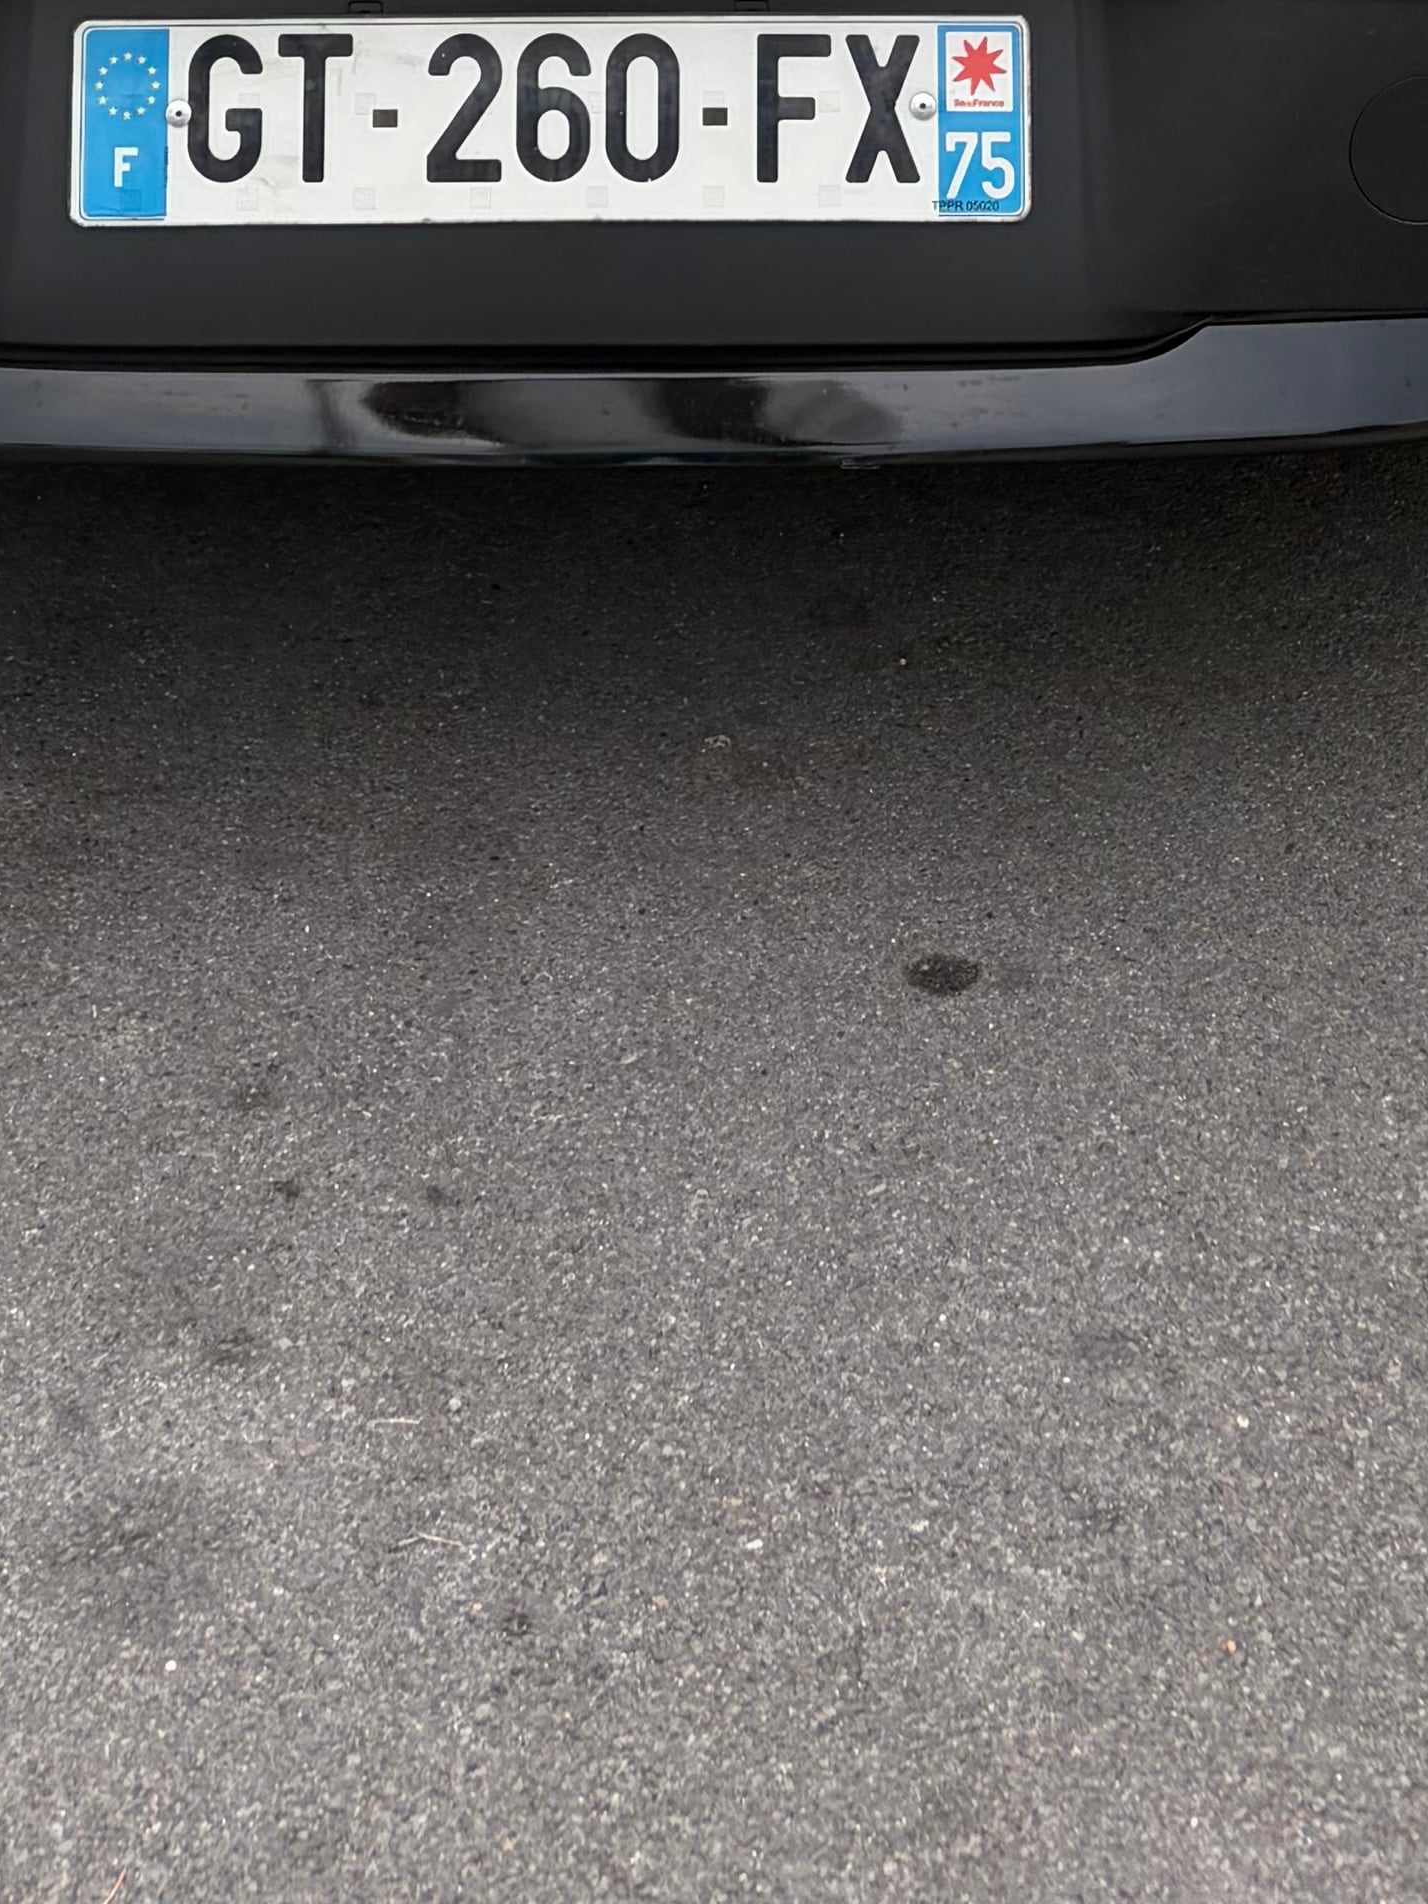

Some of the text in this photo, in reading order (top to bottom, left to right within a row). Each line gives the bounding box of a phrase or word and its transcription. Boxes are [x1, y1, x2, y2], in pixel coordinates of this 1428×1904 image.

[186, 32, 921, 184] GT-260-FX
[113, 146, 140, 188] F
[945, 130, 1015, 200] 75
